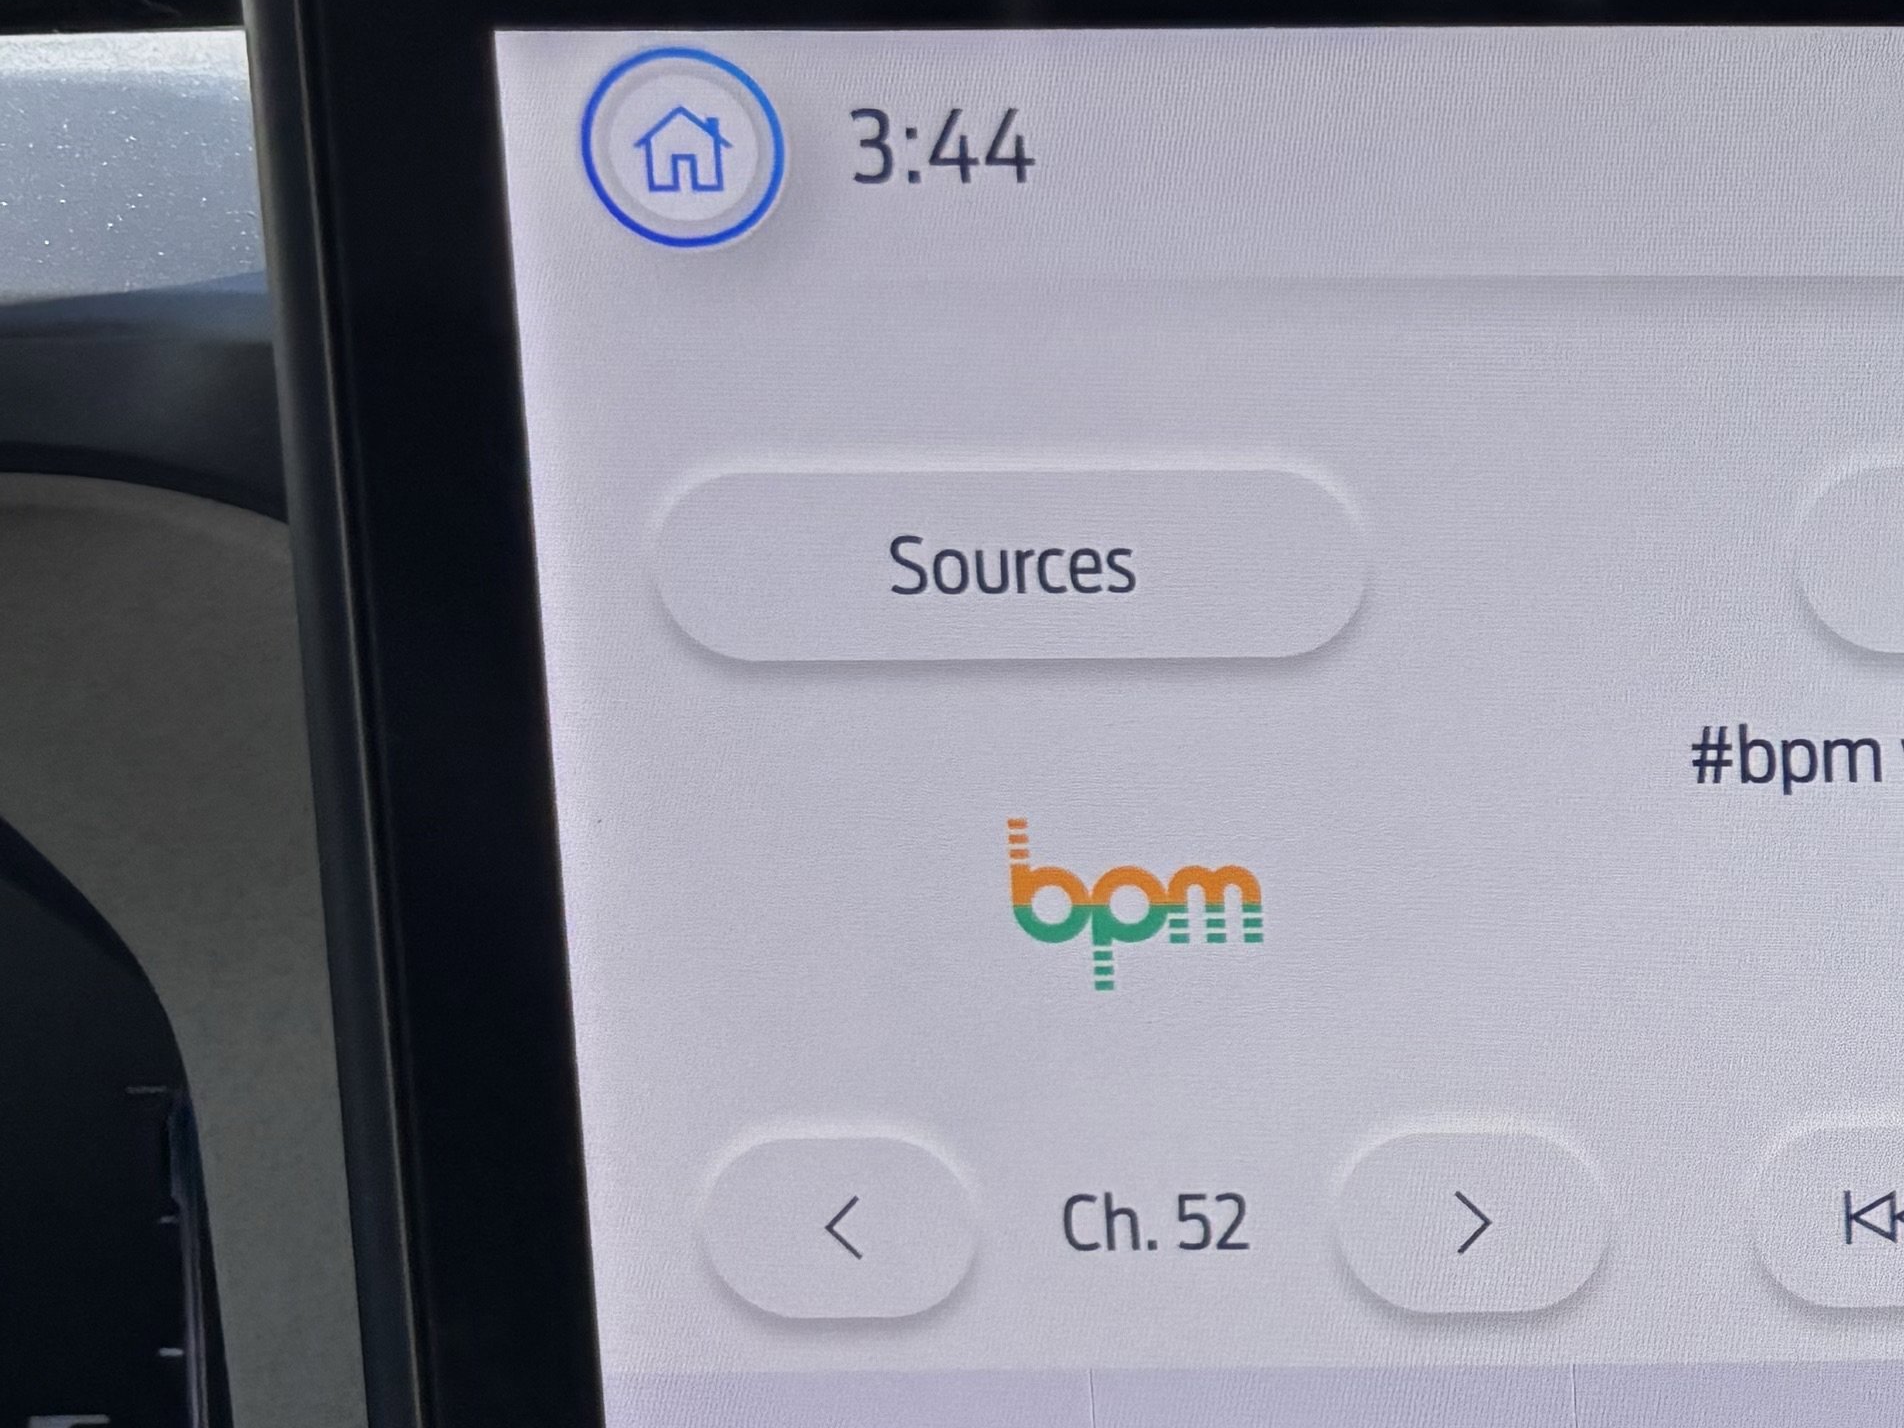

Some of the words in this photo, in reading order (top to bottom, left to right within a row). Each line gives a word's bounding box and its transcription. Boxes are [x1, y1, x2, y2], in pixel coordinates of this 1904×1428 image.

[849, 107, 1035, 185] 3:44
[889, 534, 1136, 596] Sources
[1691, 723, 1882, 796] #bpm
[1007, 818, 1263, 991] bpm
[1062, 1191, 1158, 1252] Ch.
[1177, 1192, 1250, 1251] 52
